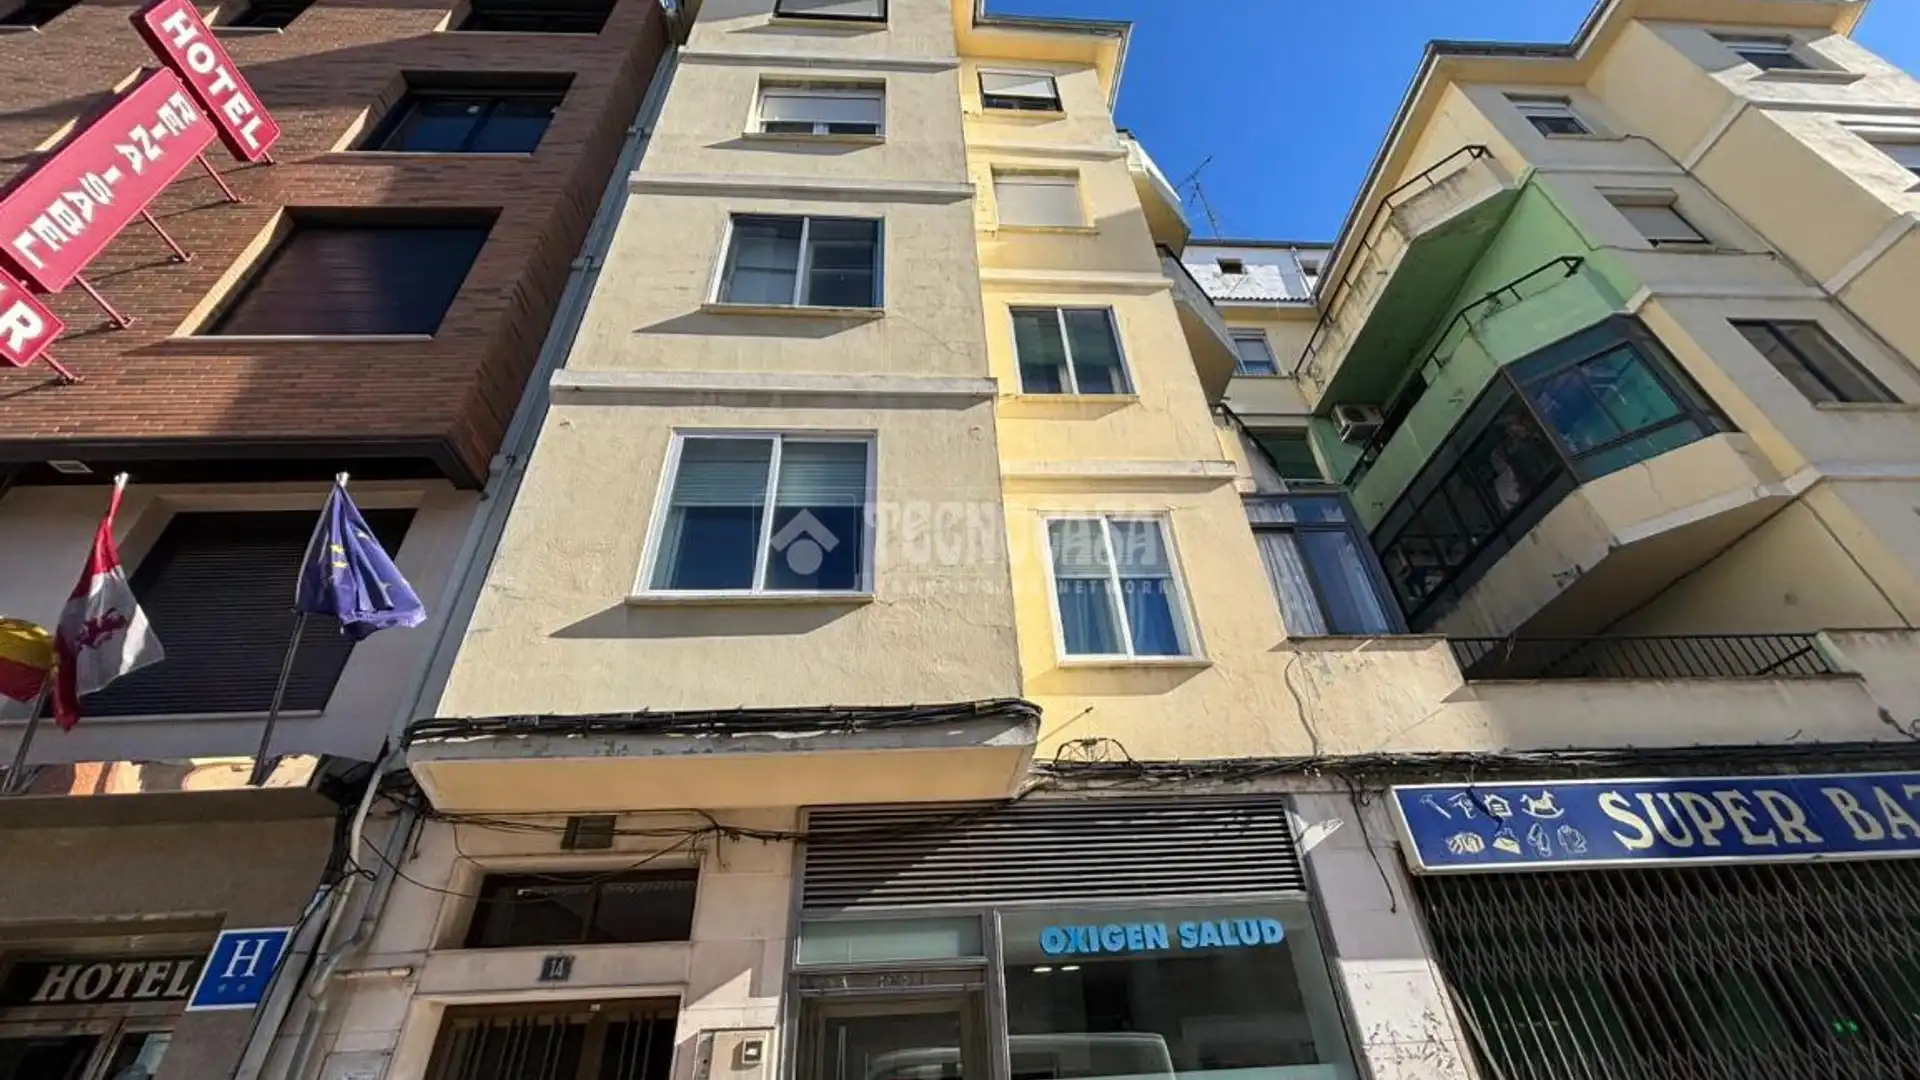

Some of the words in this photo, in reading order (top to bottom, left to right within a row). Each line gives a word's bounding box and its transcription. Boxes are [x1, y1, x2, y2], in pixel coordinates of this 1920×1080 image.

[161, 9, 267, 151] HOTEL
[114, 91, 199, 175] REINA
[12, 166, 122, 270] ISABEL
[1598, 788, 1824, 850] SUPER
[220, 938, 270, 978] H
[1040, 922, 1169, 954] OXIGEN
[1177, 918, 1284, 950] SALUD
[30, 959, 196, 1001] HOTEL
